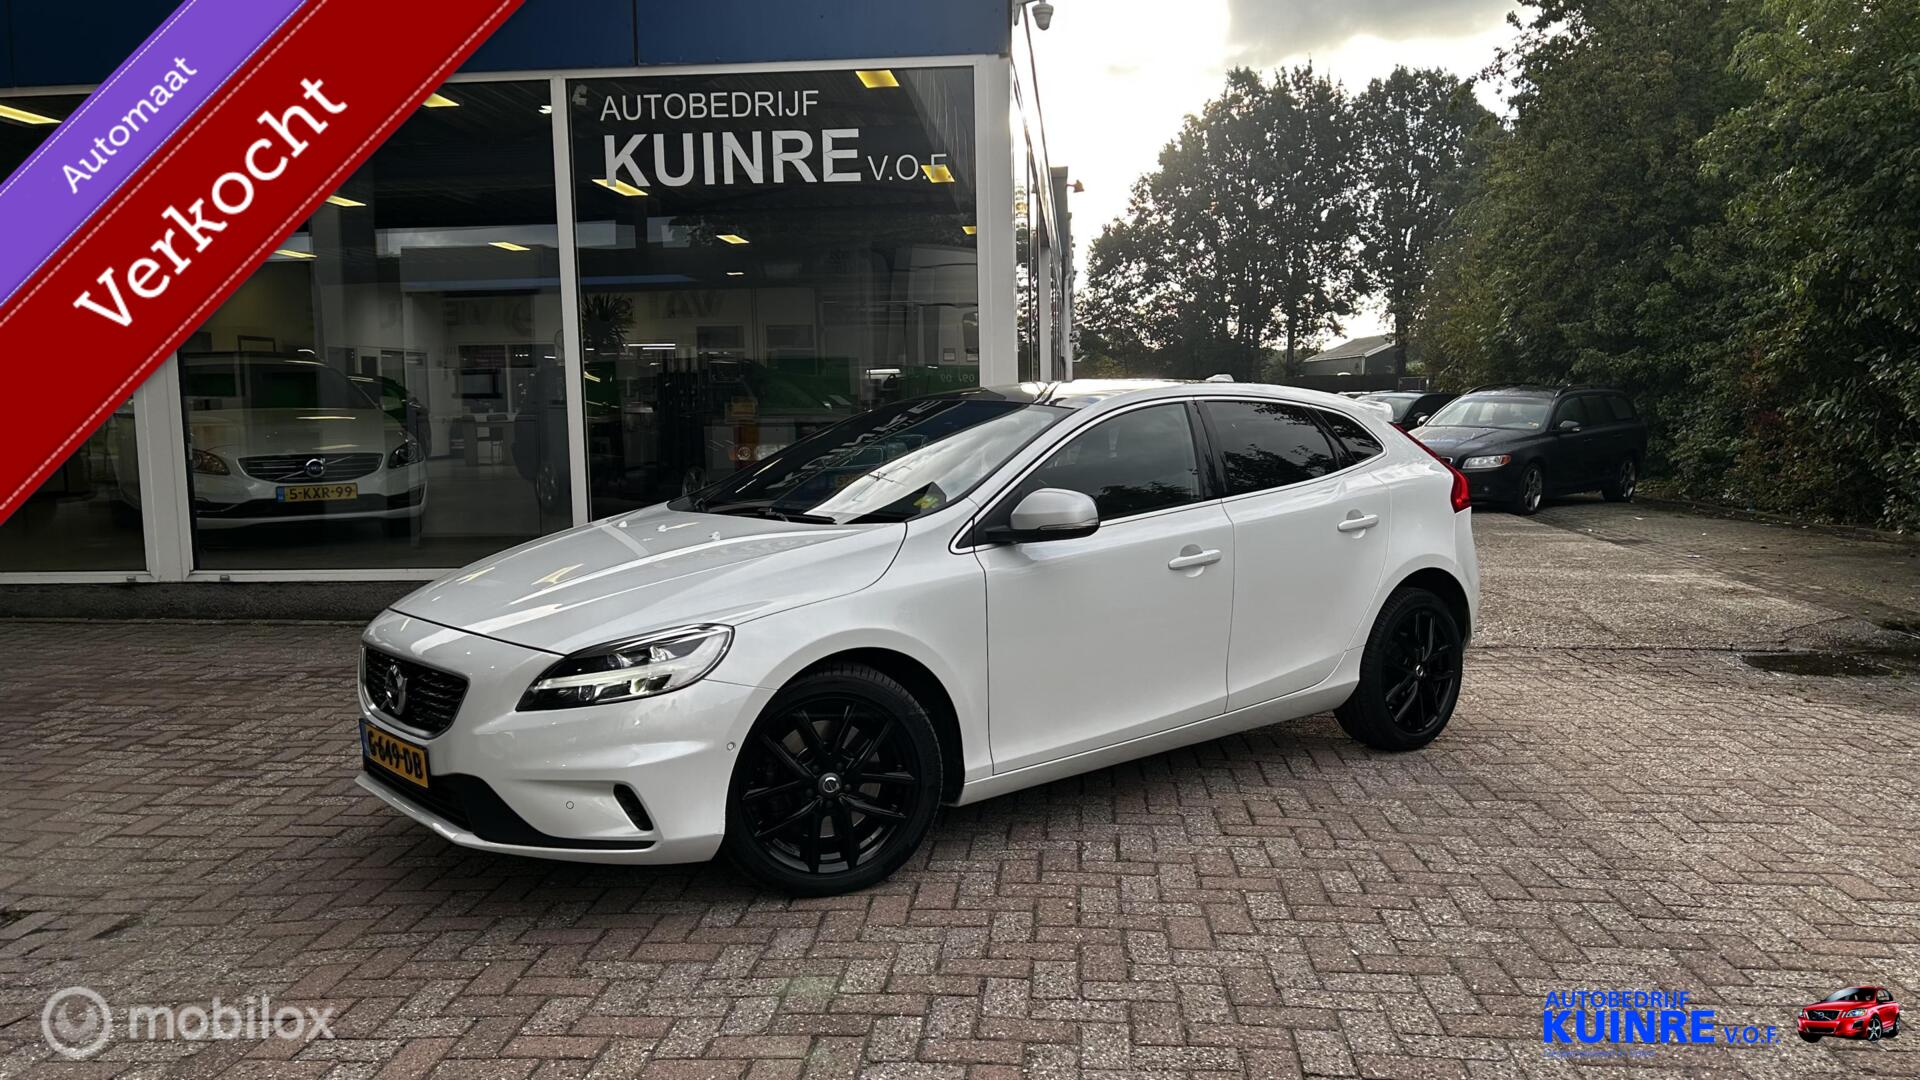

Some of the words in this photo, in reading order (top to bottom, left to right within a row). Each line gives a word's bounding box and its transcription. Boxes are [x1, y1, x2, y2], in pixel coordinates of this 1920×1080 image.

[600, 90, 819, 121] AUTOBEDRIJF
[603, 128, 863, 187] KUINRE
[288, 485, 354, 501] 5-KXR-99
[367, 729, 424, 780] G-649-DB
